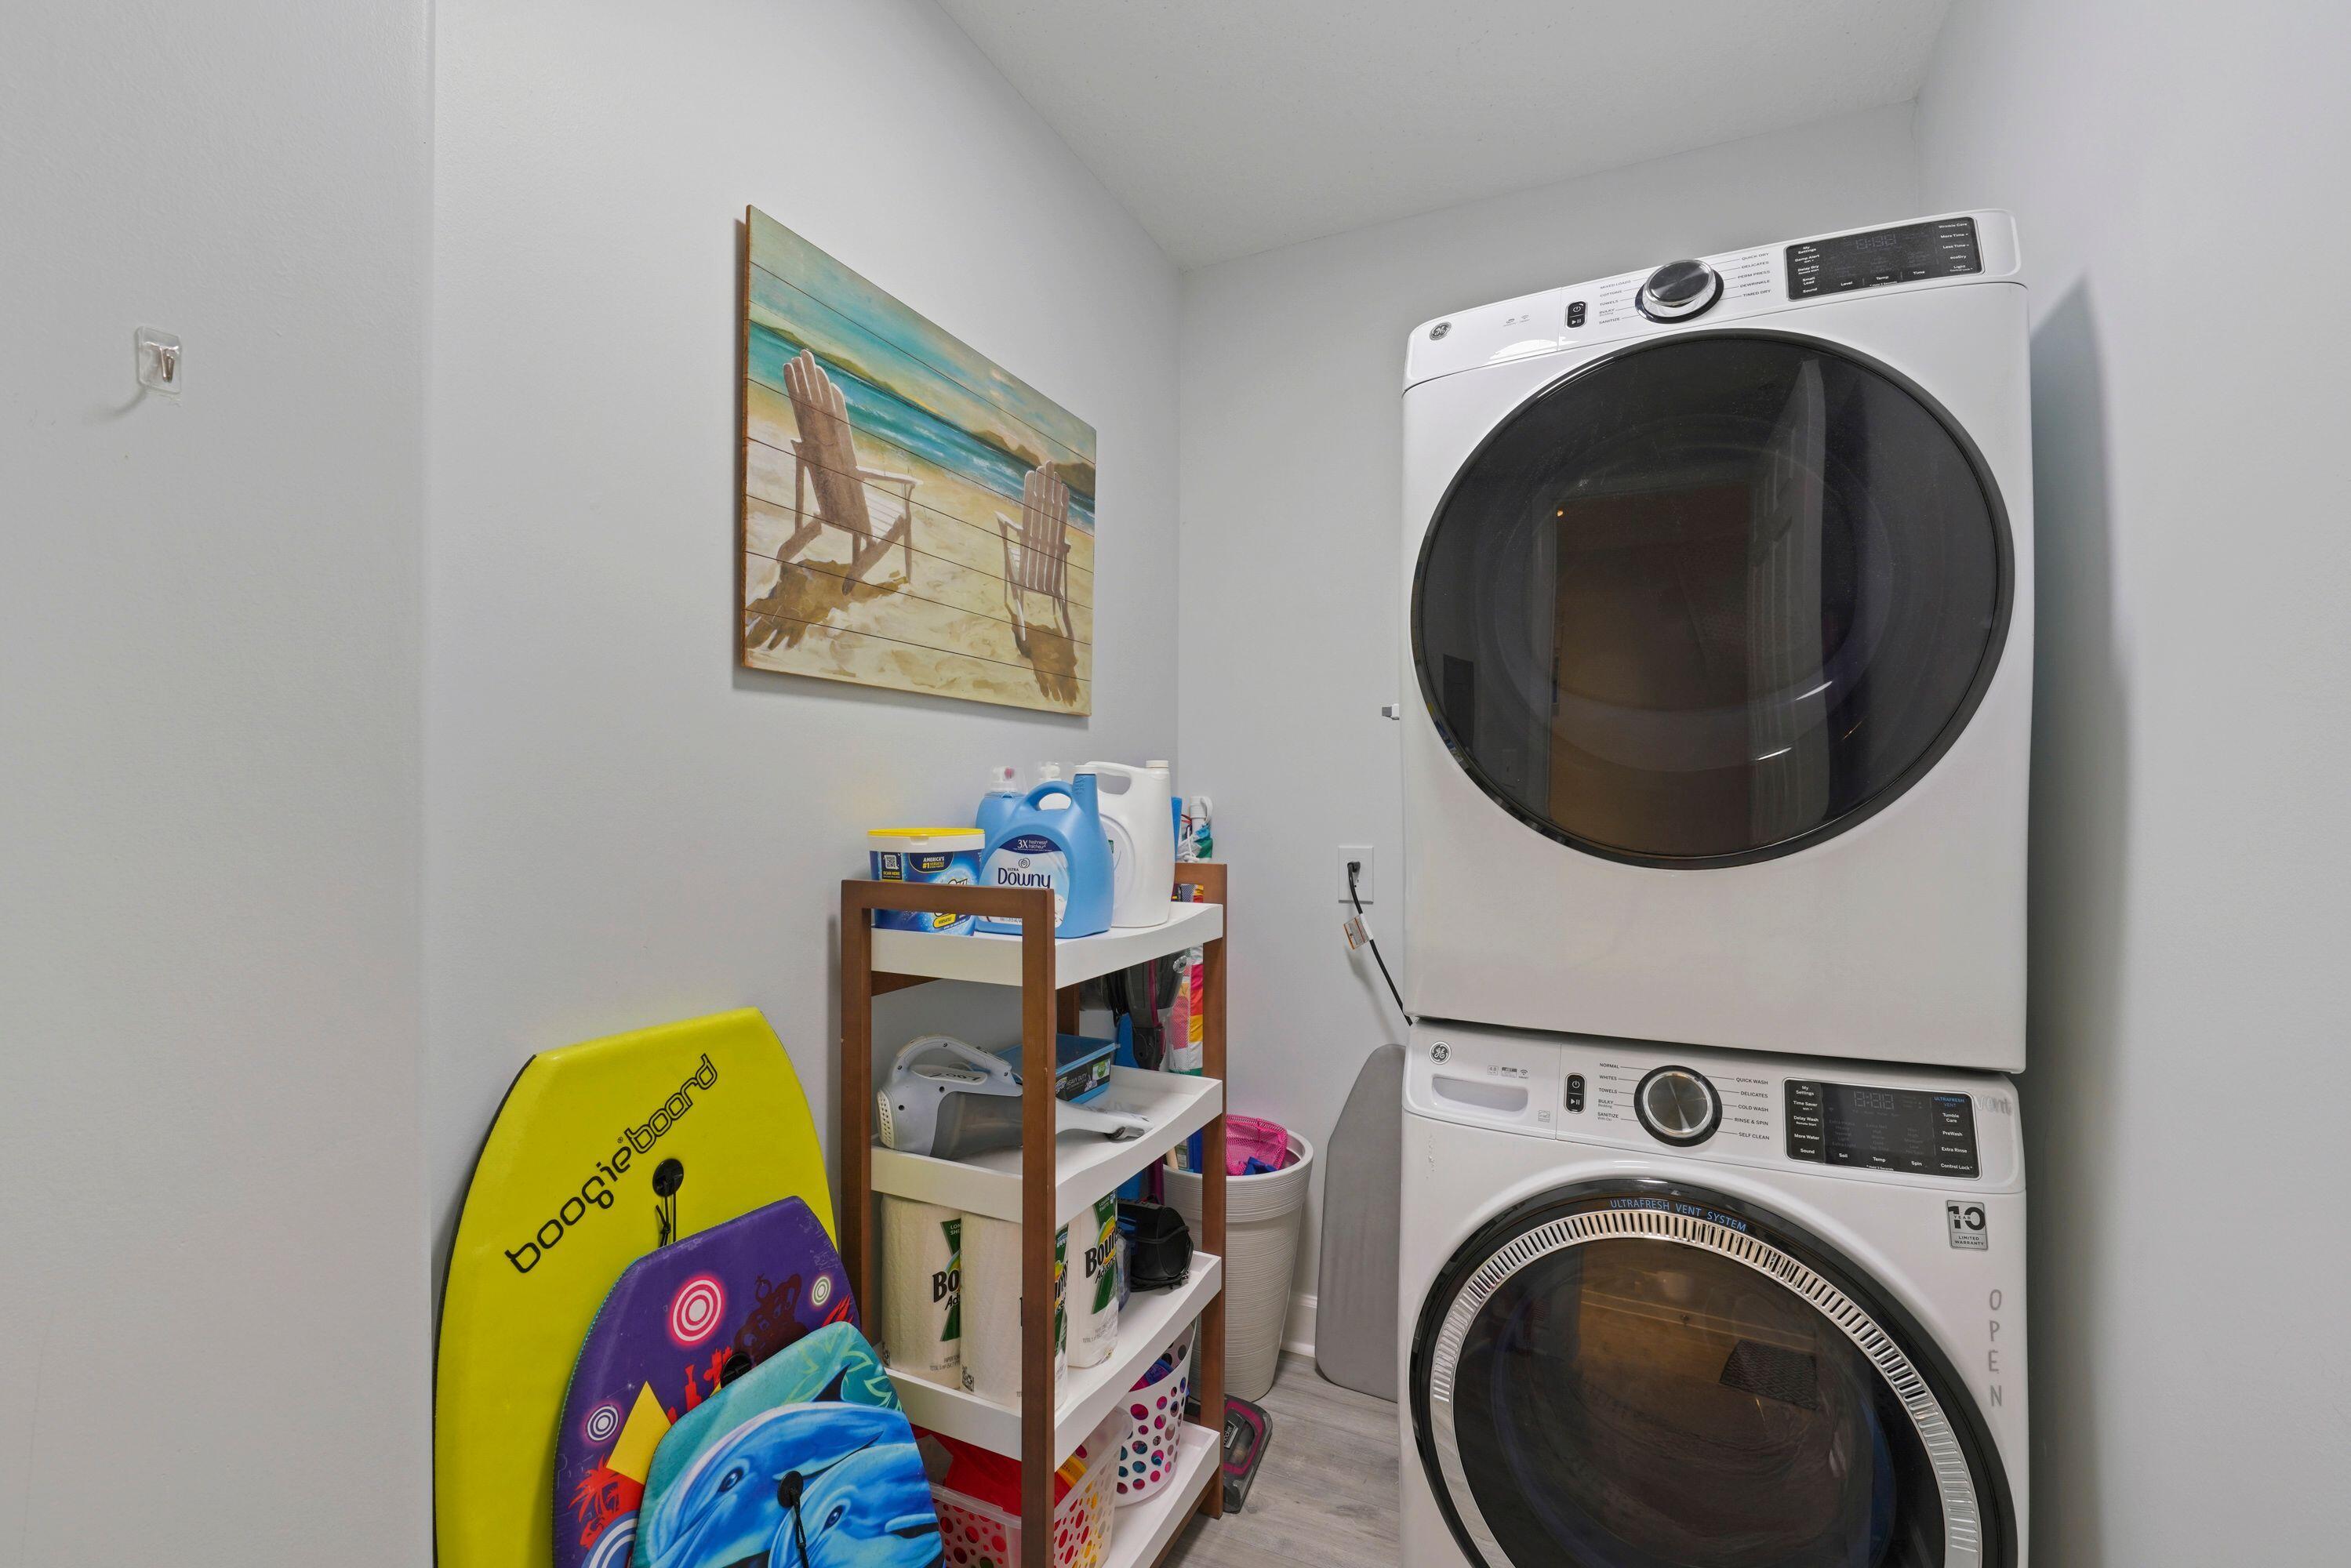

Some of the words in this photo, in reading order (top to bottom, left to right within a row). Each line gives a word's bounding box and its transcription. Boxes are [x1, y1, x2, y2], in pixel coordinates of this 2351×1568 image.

[1017, 839, 1028, 849] 3X
[997, 867, 1051, 889] Downy
[1610, 1198, 1670, 1211] ULTRAFRESH
[1675, 1203, 1702, 1217] VENT
[1707, 1211, 1746, 1232] SYSTEM
[1948, 1206, 1986, 1231] 10
[1988, 1289, 2003, 1407] OPEN
